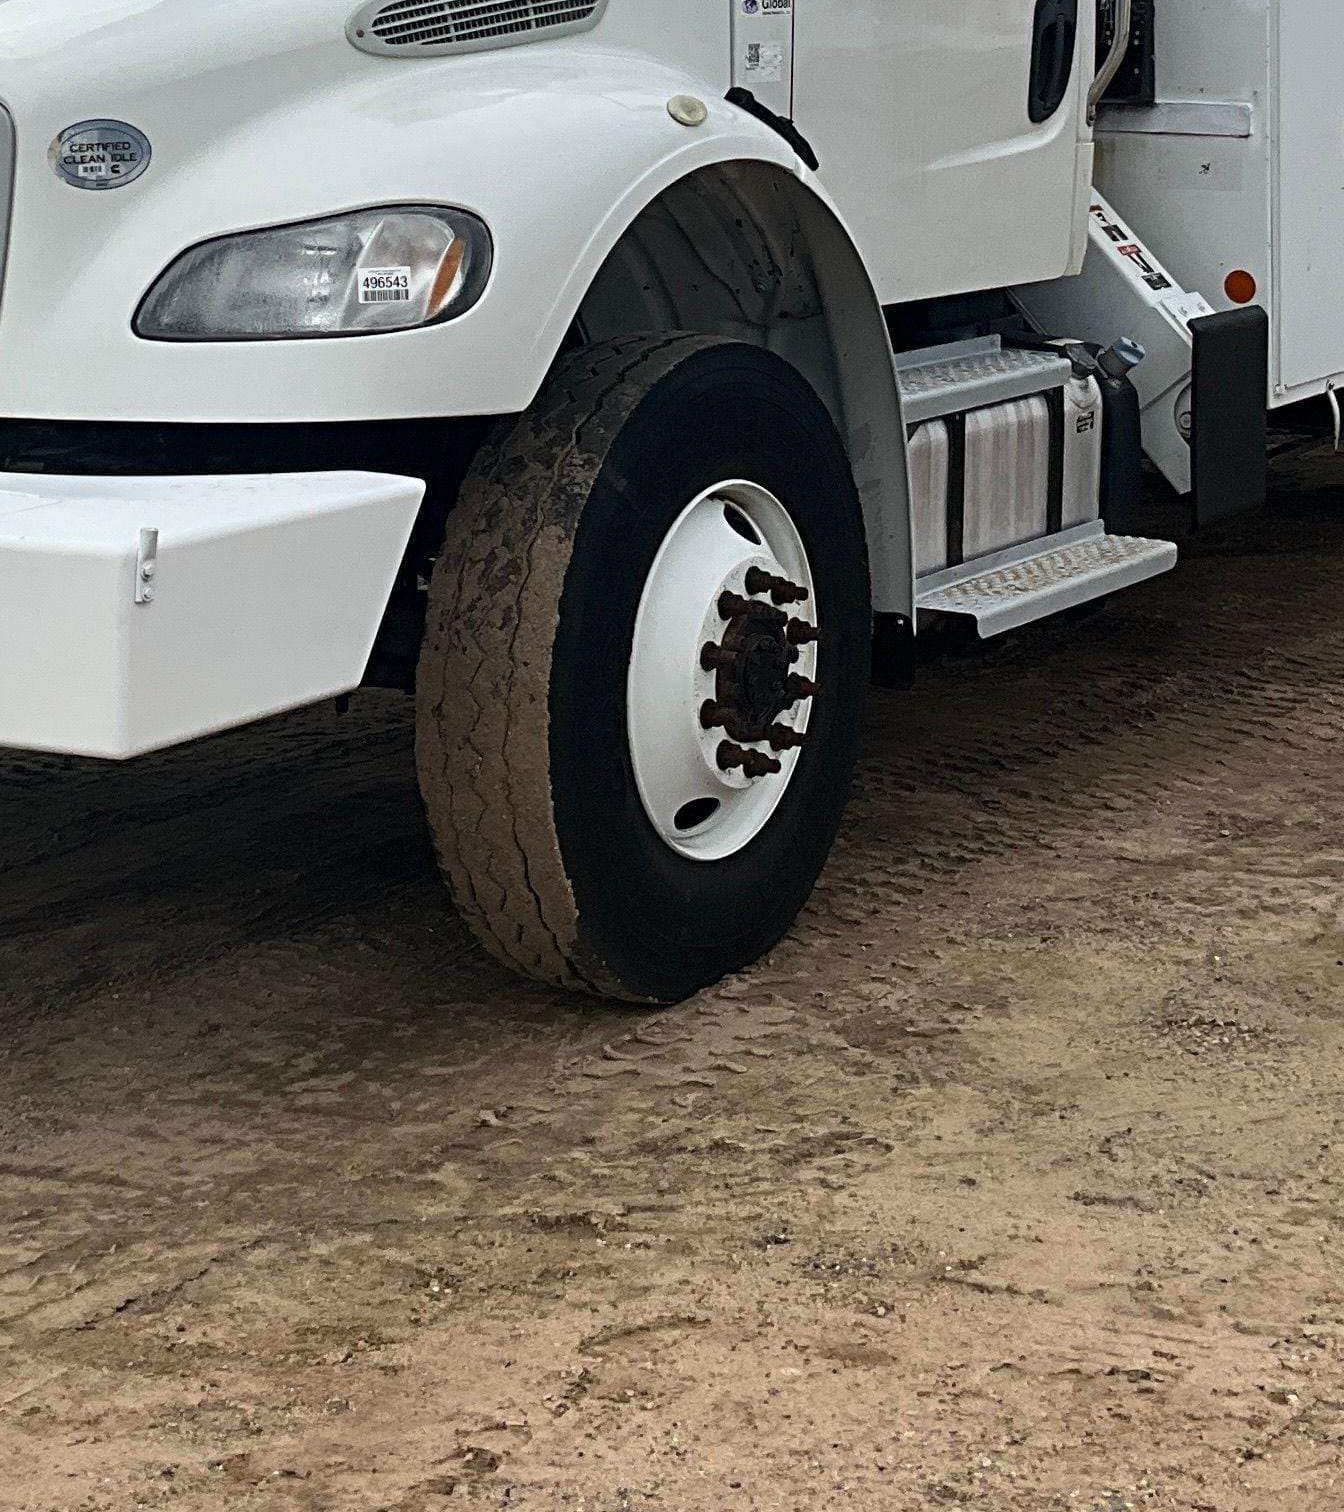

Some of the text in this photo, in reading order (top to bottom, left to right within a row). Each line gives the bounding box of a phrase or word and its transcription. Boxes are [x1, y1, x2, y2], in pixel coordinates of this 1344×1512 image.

[69, 141, 131, 153] CERTIFIED
[63, 153, 138, 165] CLEAN IDLE
[362, 275, 408, 289] 496543
